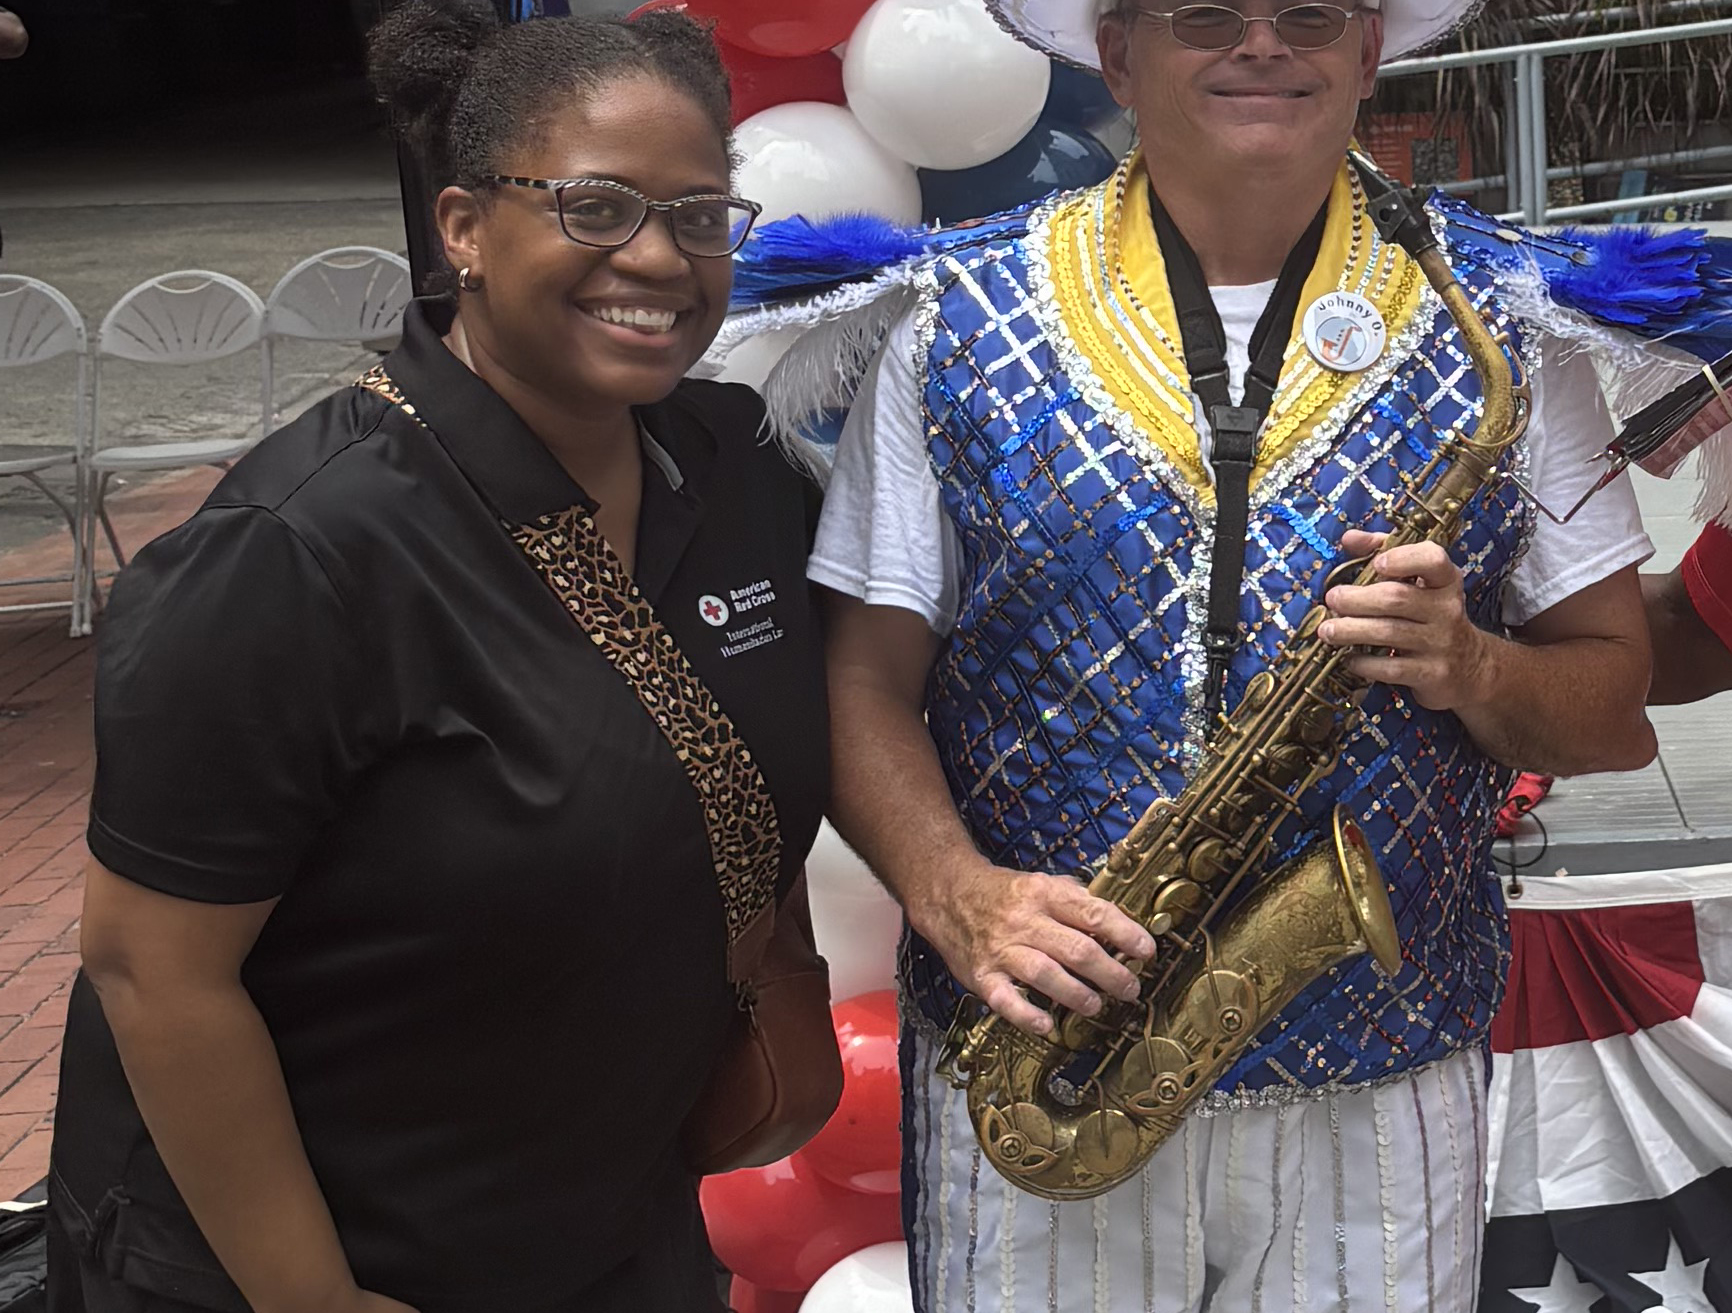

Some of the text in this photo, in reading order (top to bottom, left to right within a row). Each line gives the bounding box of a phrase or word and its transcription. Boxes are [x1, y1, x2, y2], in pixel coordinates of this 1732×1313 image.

[1318, 295, 1372, 319] Johnny
[730, 580, 771, 600] American
[734, 591, 776, 612] Red Cross
